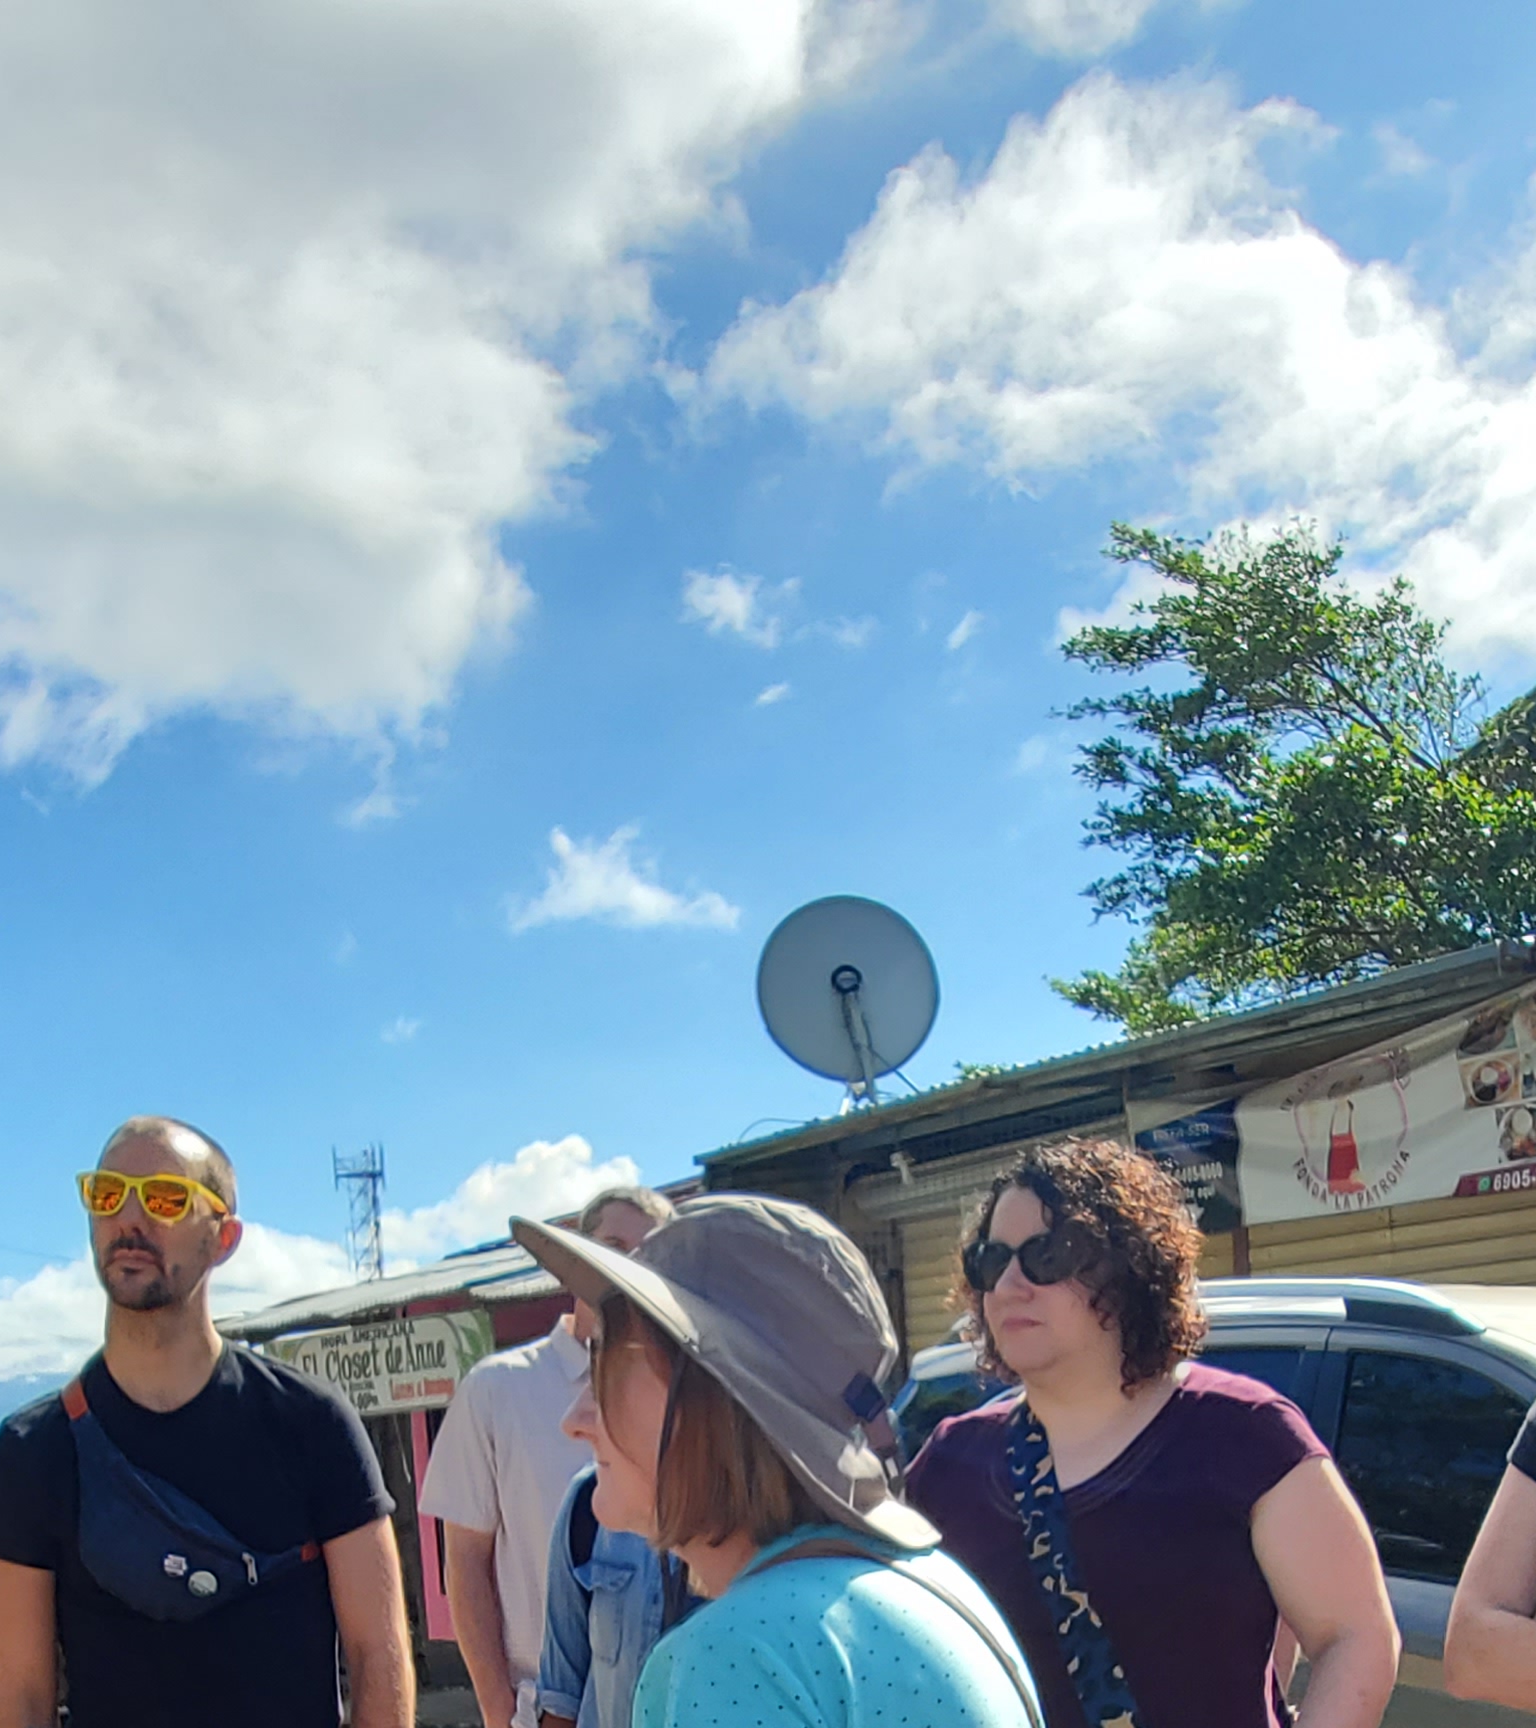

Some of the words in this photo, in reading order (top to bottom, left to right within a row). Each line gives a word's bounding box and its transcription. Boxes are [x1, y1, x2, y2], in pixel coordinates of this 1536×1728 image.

[1292, 1157, 1328, 1204] FONDA
[1334, 1192, 1351, 1211] LA
[1357, 1150, 1411, 1209] PATRONA
[320, 1332, 348, 1350] ROPA
[352, 1320, 415, 1344] AMERICANA
[325, 1338, 382, 1386] Closet
[385, 1337, 404, 1375] de
[404, 1330, 447, 1373] Anne
